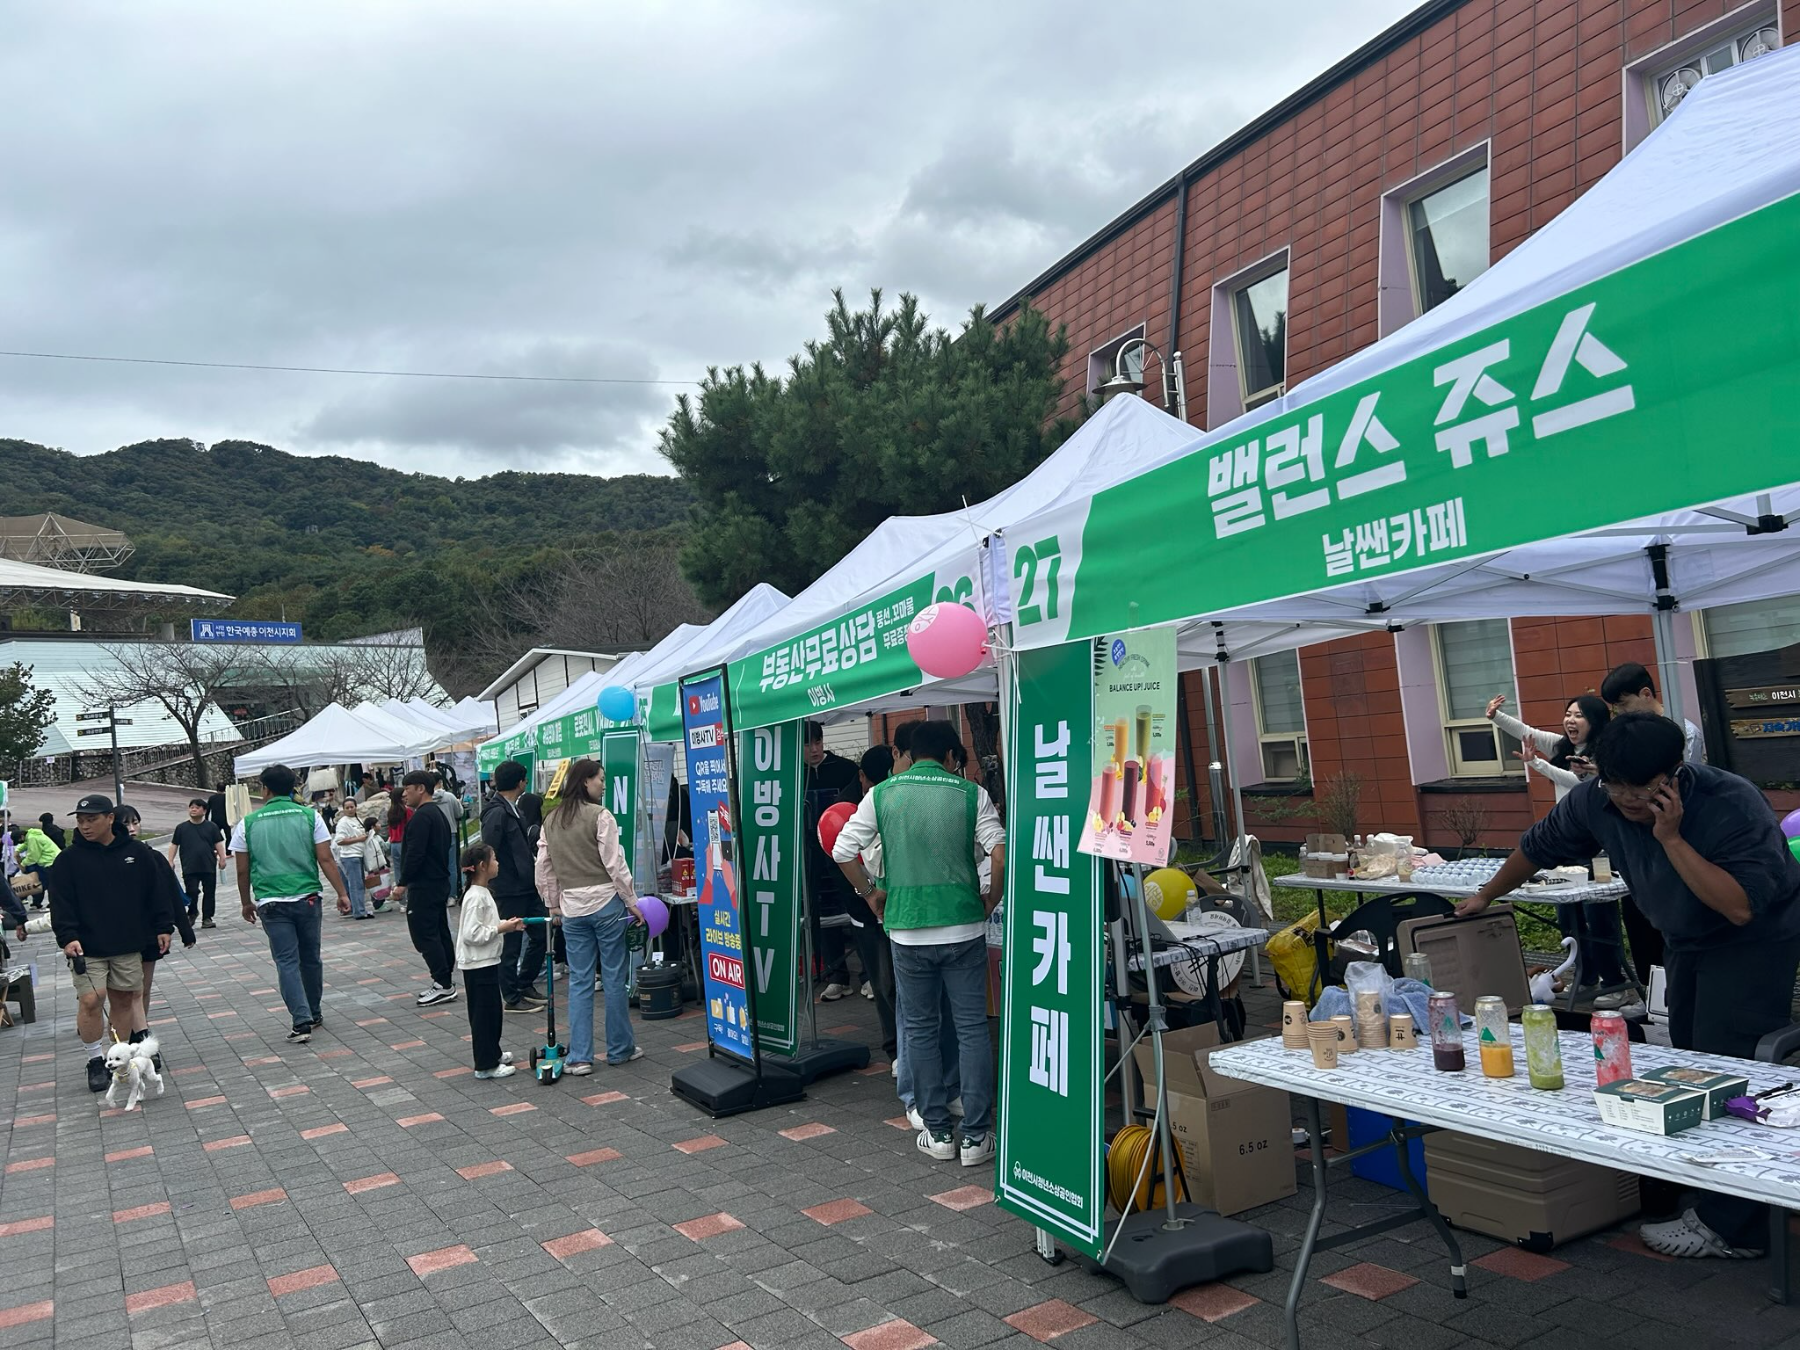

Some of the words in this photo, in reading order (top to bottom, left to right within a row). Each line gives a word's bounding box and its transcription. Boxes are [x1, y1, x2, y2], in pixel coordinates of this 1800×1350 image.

[1208, 391, 1406, 539] 밸런스
[1433, 302, 1635, 469] 쥬스
[1322, 497, 1468, 577] 날쌘카페
[1013, 535, 1061, 626] 27
[226, 625, 258, 638] 한국예총
[258, 627, 297, 638] 이천시지회
[759, 610, 878, 693] 부동산무료상담
[807, 683, 836, 707] 이방사
[1109, 683, 1133, 692] BALANCE
[1144, 681, 1160, 691] JUICE
[1771, 690, 1796, 700] 이천시
[698, 692, 719, 713] YouTube
[13, 883, 31, 893] NIKE
[714, 910, 731, 927] 실시간
[1029, 720, 1071, 1097] 날쌘카페
[705, 927, 723, 945] 라이브
[712, 958, 726, 977] ON
[727, 963, 743, 984] AIR
[1178, 1125, 1187, 1133] oz
[1239, 1141, 1254, 1155] 6.5
[1257, 1140, 1268, 1151] oz
[1022, 1168, 1083, 1209] 이천시청년소상공인협회
